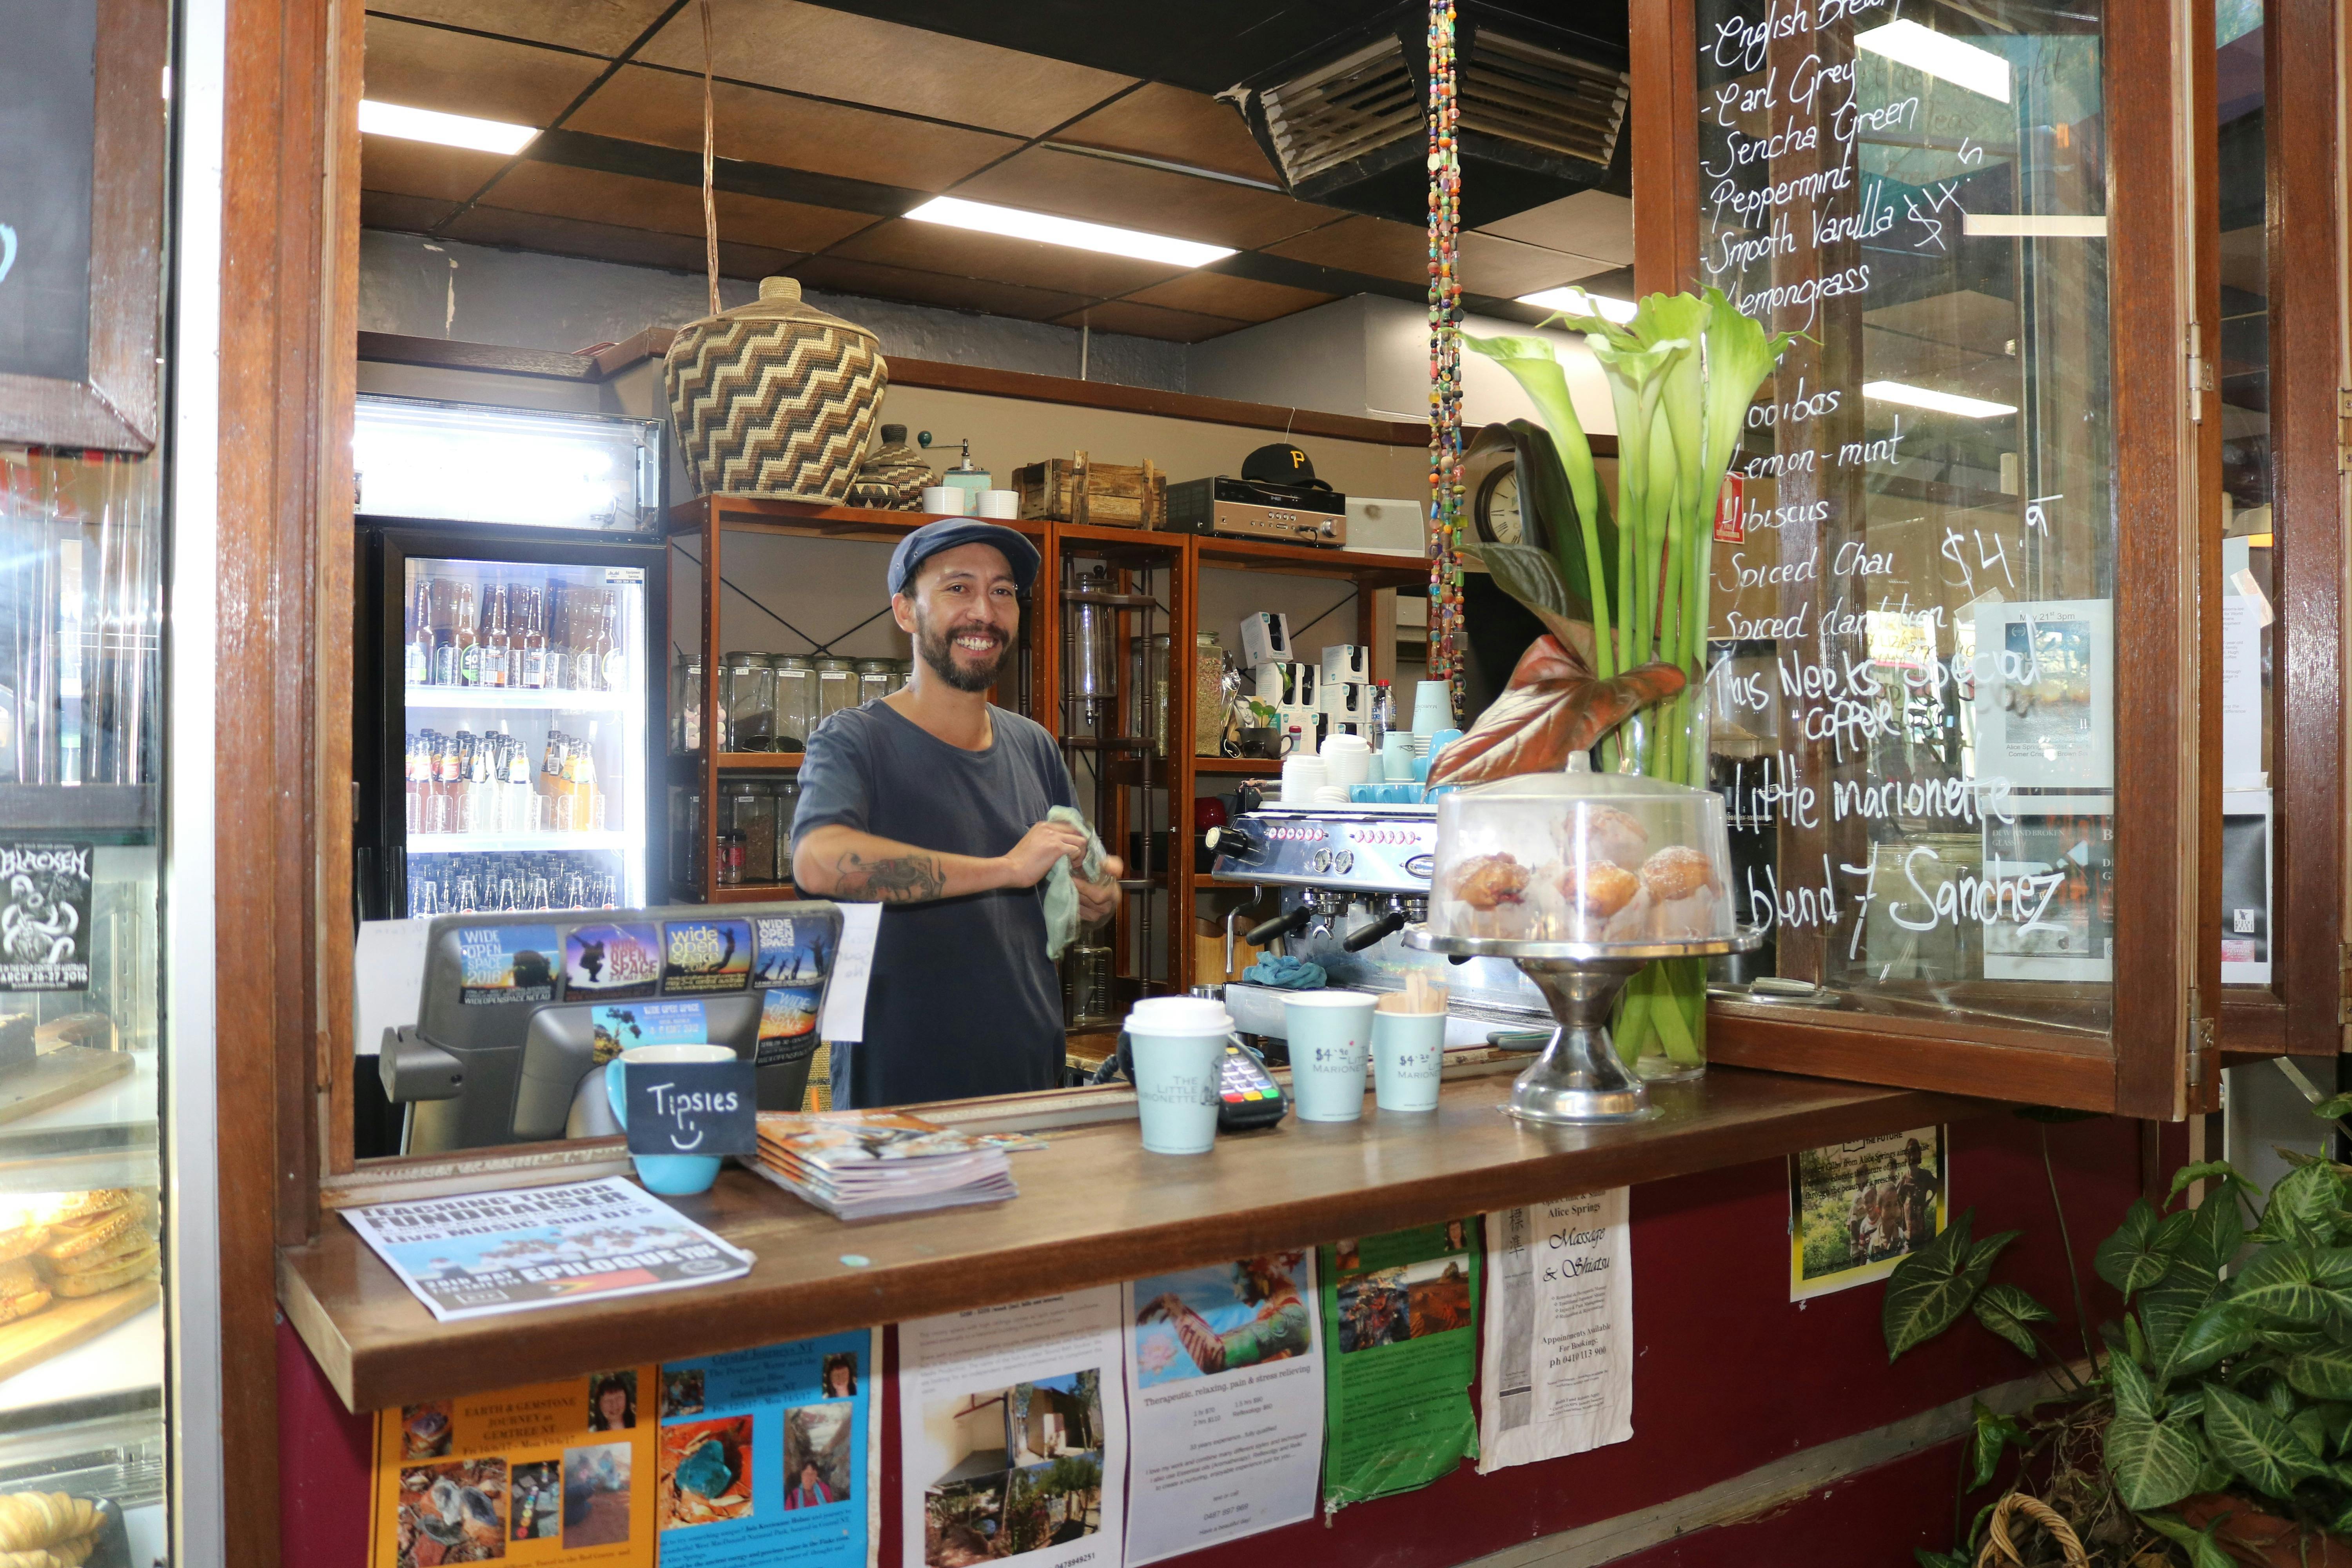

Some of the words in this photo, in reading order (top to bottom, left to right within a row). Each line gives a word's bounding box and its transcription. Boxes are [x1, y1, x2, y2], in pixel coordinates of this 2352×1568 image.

[1789, 54, 1857, 114] Grey
[1831, 97, 1918, 143] Green
[1811, 179, 1895, 245] Vanilla
[1749, 377, 1840, 428] ooibos
[1290, 450, 1305, 468] P
[1834, 542, 1893, 575] Chai
[2057, 613, 2075, 621] 3pm
[1706, 652, 1769, 715] This
[1834, 731, 2014, 824] marionette
[1748, 854, 1842, 931] blend
[1890, 847, 2069, 937] Sanchez
[758, 919, 792, 929] WIDE
[464, 930, 499, 944] WIDE
[671, 926, 719, 942] wide
[759, 928, 793, 938] OPEN
[467, 943, 502, 958] OPEN
[671, 940, 719, 956] open
[760, 938, 794, 947] SPACE
[468, 957, 501, 970] SPACE
[611, 947, 648, 965] OPEN
[673, 952, 719, 967] space
[610, 960, 658, 975] SPACE
[0, 971, 29, 983] ARCH
[780, 993, 811, 1008] WIDE
[769, 1004, 800, 1018] OPEN
[769, 1015, 804, 1031] SPACE
[1172, 1076, 1198, 1085] THE
[1157, 1084, 1198, 1094] LITTLE
[1877, 1132, 1903, 1143] FUTURE
[1843, 1158, 1858, 1167] from
[1859, 1156, 1874, 1165] Alice
[1874, 1151, 1896, 1163] Springs
[1805, 1188, 1830, 1200] through
[1831, 1186, 1840, 1194] the
[1841, 1183, 1861, 1193] beauty
[361, 1196, 513, 1217] TEACHING
[513, 1183, 613, 1202] TIMOR
[365, 1192, 630, 1229] FUNDRAISER
[1548, 1207, 1570, 1218] Alice
[1571, 1203, 1601, 1215] Springs
[447, 1218, 539, 1238] MUSIC
[548, 1212, 598, 1225] and
[1549, 1227, 1606, 1249] Massage
[519, 1247, 683, 1283] EPILOGUE
[1543, 1267, 1558, 1282] &
[1562, 1256, 1610, 1278] Shiatsu
[1541, 1330, 1586, 1345] Appointments
[1587, 1322, 1611, 1335] Available
[1571, 1338, 1599, 1350] Bookings:
[1549, 1357, 1561, 1368] ph
[1563, 1352, 1579, 1364] 0410
[1580, 1349, 1593, 1360] 113
[1594, 1345, 1607, 1356] 900
[1229, 1379, 1247, 1390] pain
[1248, 1376, 1254, 1385] &
[1256, 1371, 1278, 1383] stress
[1279, 1365, 1311, 1377] relieving
[1198, 1441, 1212, 1450] years
[1256, 1425, 1277, 1436] qualified
[1280, 1432, 1307, 1443] techniques
[1203, 1509, 1221, 1521] 0487
[1222, 1506, 1234, 1517] 897
[1236, 1502, 1249, 1513] 969
